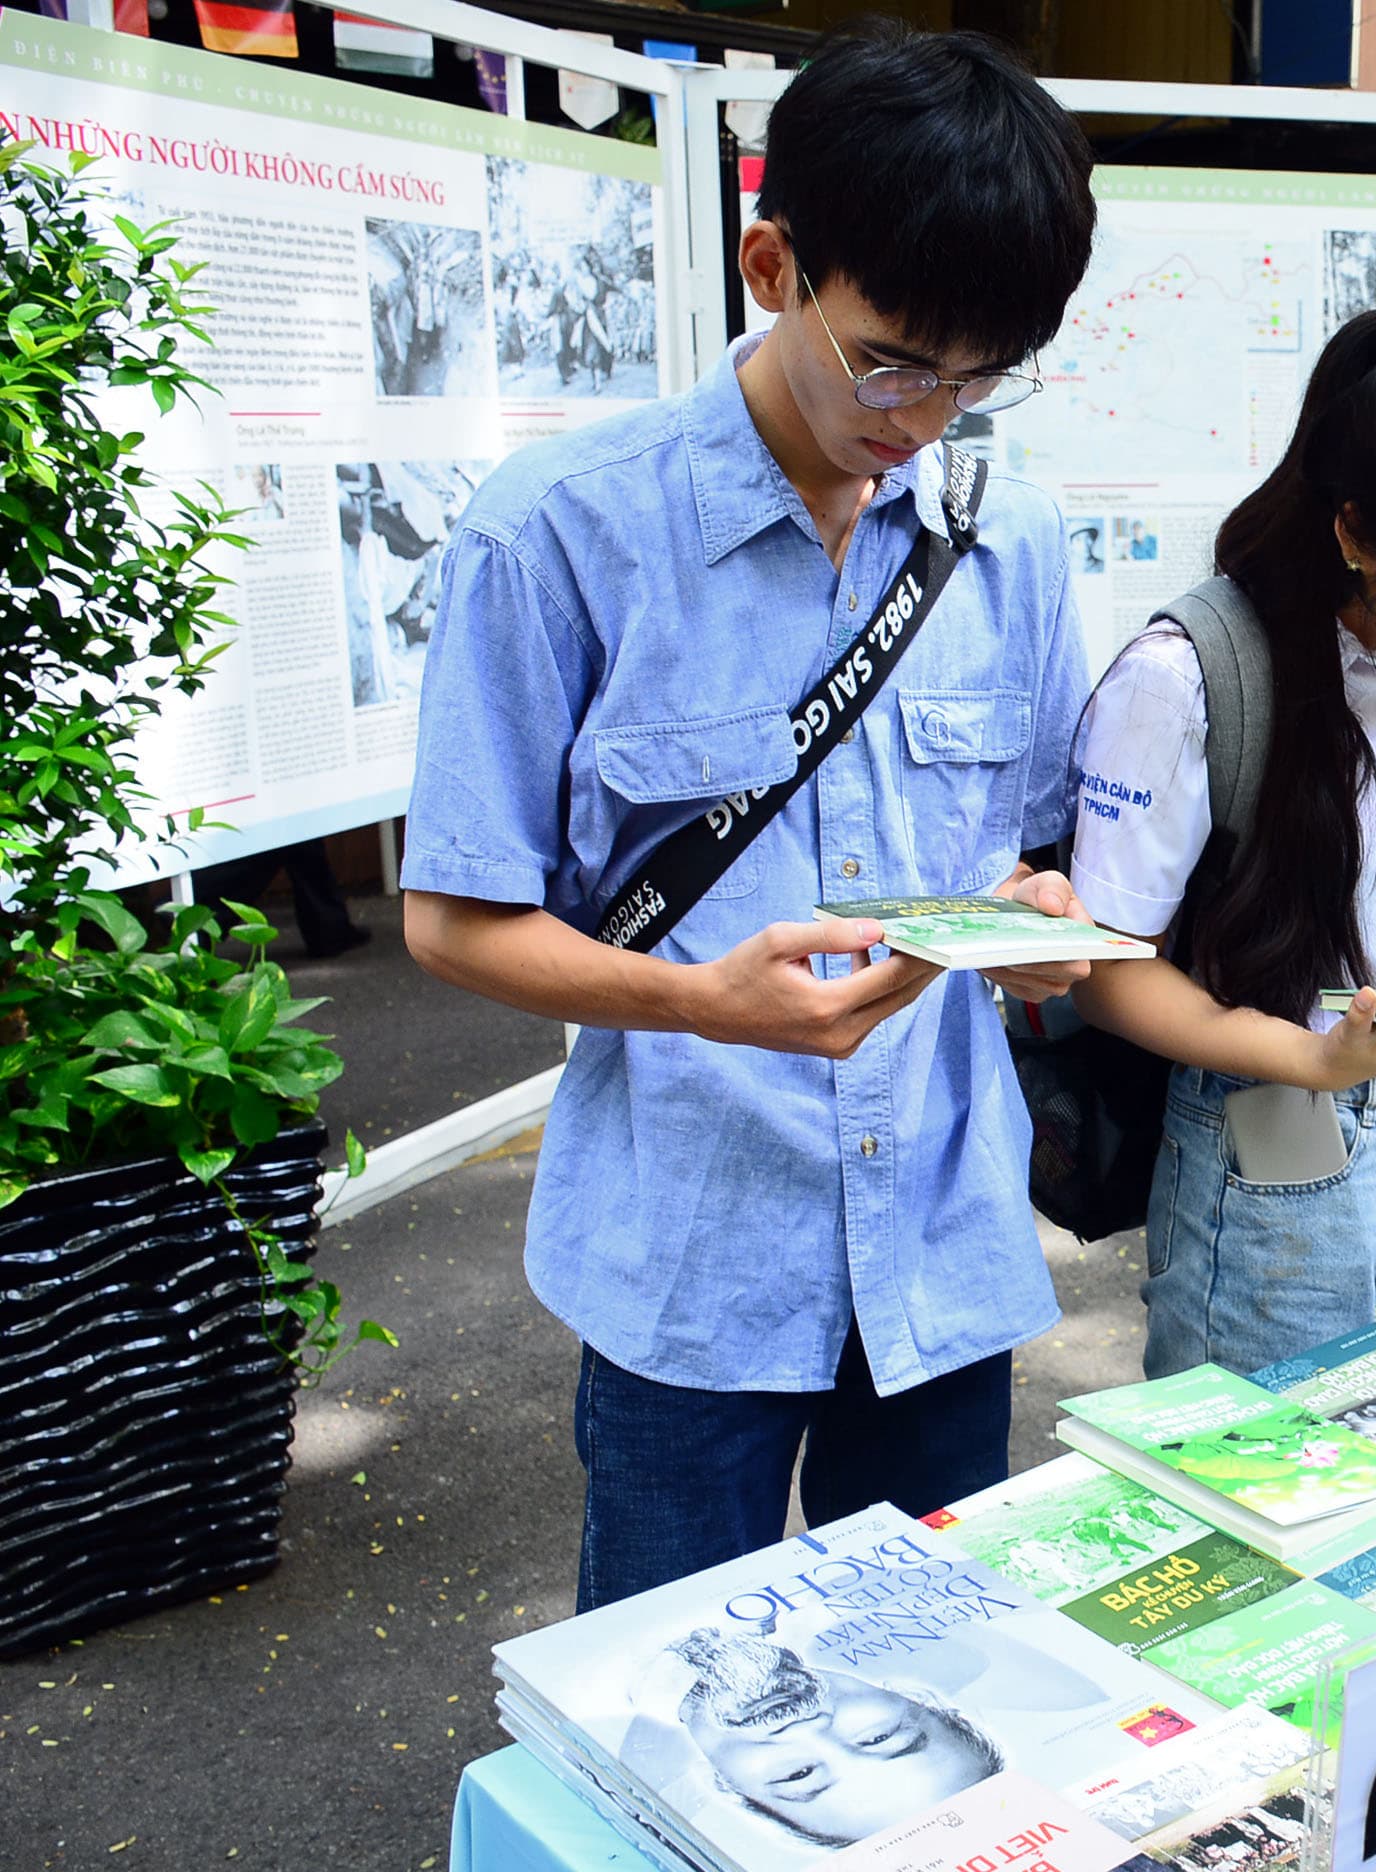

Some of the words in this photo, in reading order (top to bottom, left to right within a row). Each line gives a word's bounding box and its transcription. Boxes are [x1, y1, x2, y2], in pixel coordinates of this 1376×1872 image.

[27, 115, 143, 162] NHỮNG
[149, 136, 239, 176] NGƯỜI
[244, 150, 333, 190] KHÔNG
[390, 171, 445, 206] SÚNG
[867, 572, 923, 652] 1982.
[827, 645, 873, 712] SAI
[1083, 796, 1120, 821] TPHCM
[1109, 782, 1131, 802] CÁN
[1133, 789, 1152, 810] BỘ
[612, 891, 667, 949] FASHION
[813, 1534, 934, 1591] BÁC
[898, 1559, 954, 1593] CÓ
[1100, 1575, 1164, 1612] BÁC
[1152, 1555, 1200, 1585] HỒ
[822, 1579, 906, 1619] TÊN
[910, 1574, 990, 1612] ĐẸP
[1130, 1603, 1173, 1629] TÂY
[1171, 1588, 1204, 1611] DU
[813, 1603, 928, 1652] NHẤT
[929, 1595, 1021, 1635] VIỆT
[840, 1621, 948, 1667] NAM
[1268, 1671, 1307, 1694] BÁC
